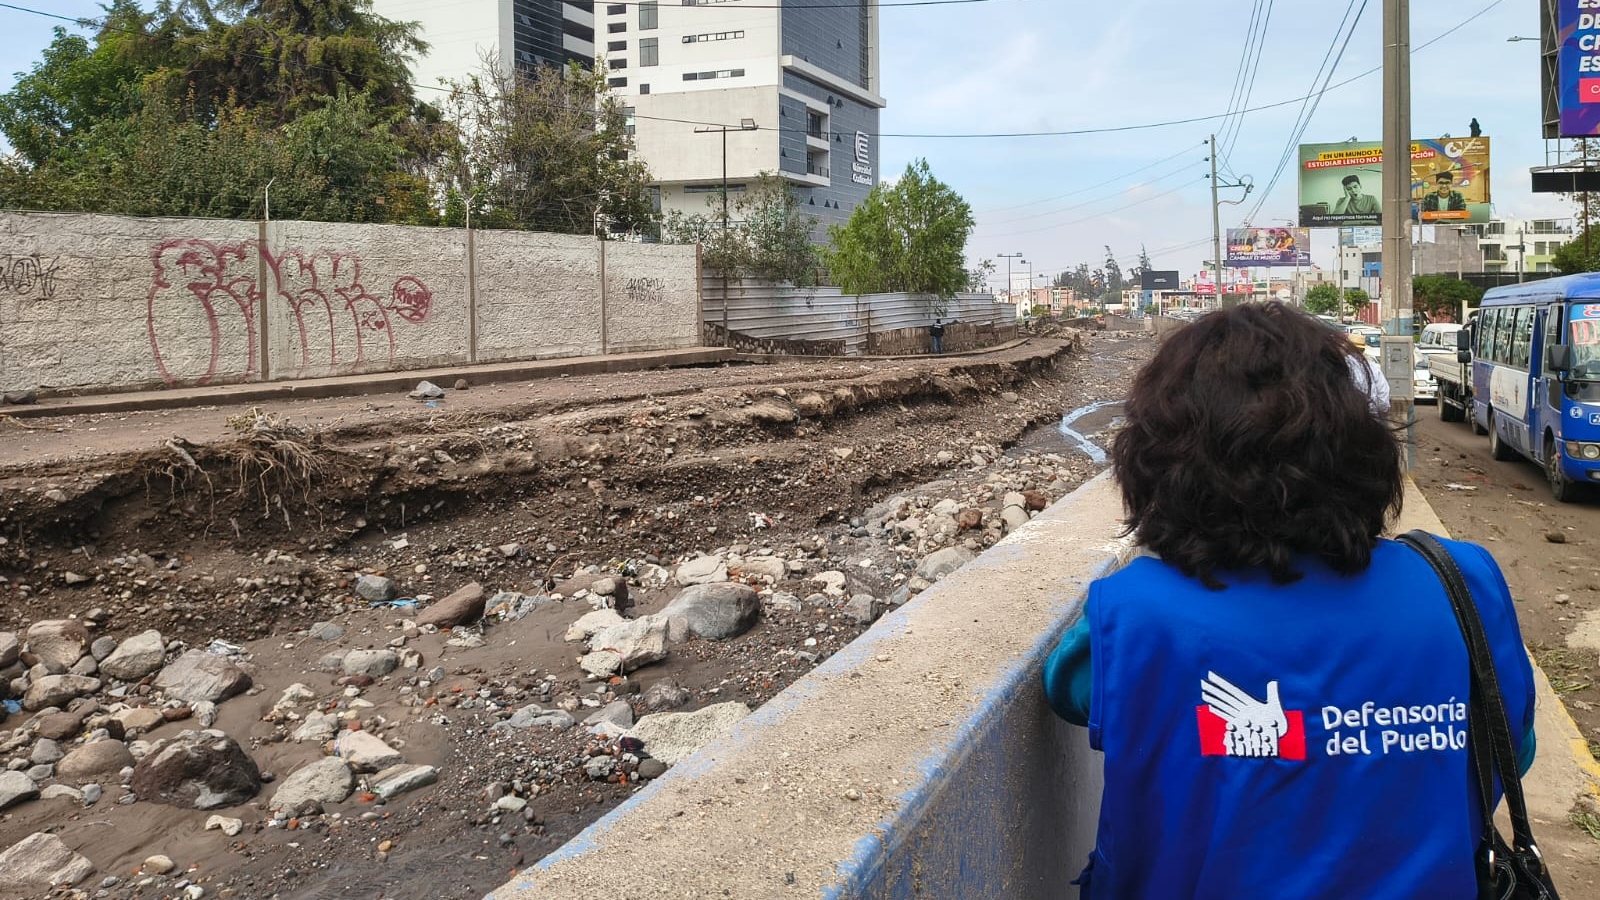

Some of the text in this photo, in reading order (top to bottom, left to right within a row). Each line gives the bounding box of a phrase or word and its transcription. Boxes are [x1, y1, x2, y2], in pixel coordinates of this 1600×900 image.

[1308, 160, 1341, 168] ESTUDIAR
[1343, 157, 1365, 165] LENTO
[1410, 150, 1434, 159] PCIÓN
[1346, 149, 1372, 157] MUNDO
[1321, 696, 1466, 729] Defensoría
[1326, 725, 1466, 756] del Pueblo
